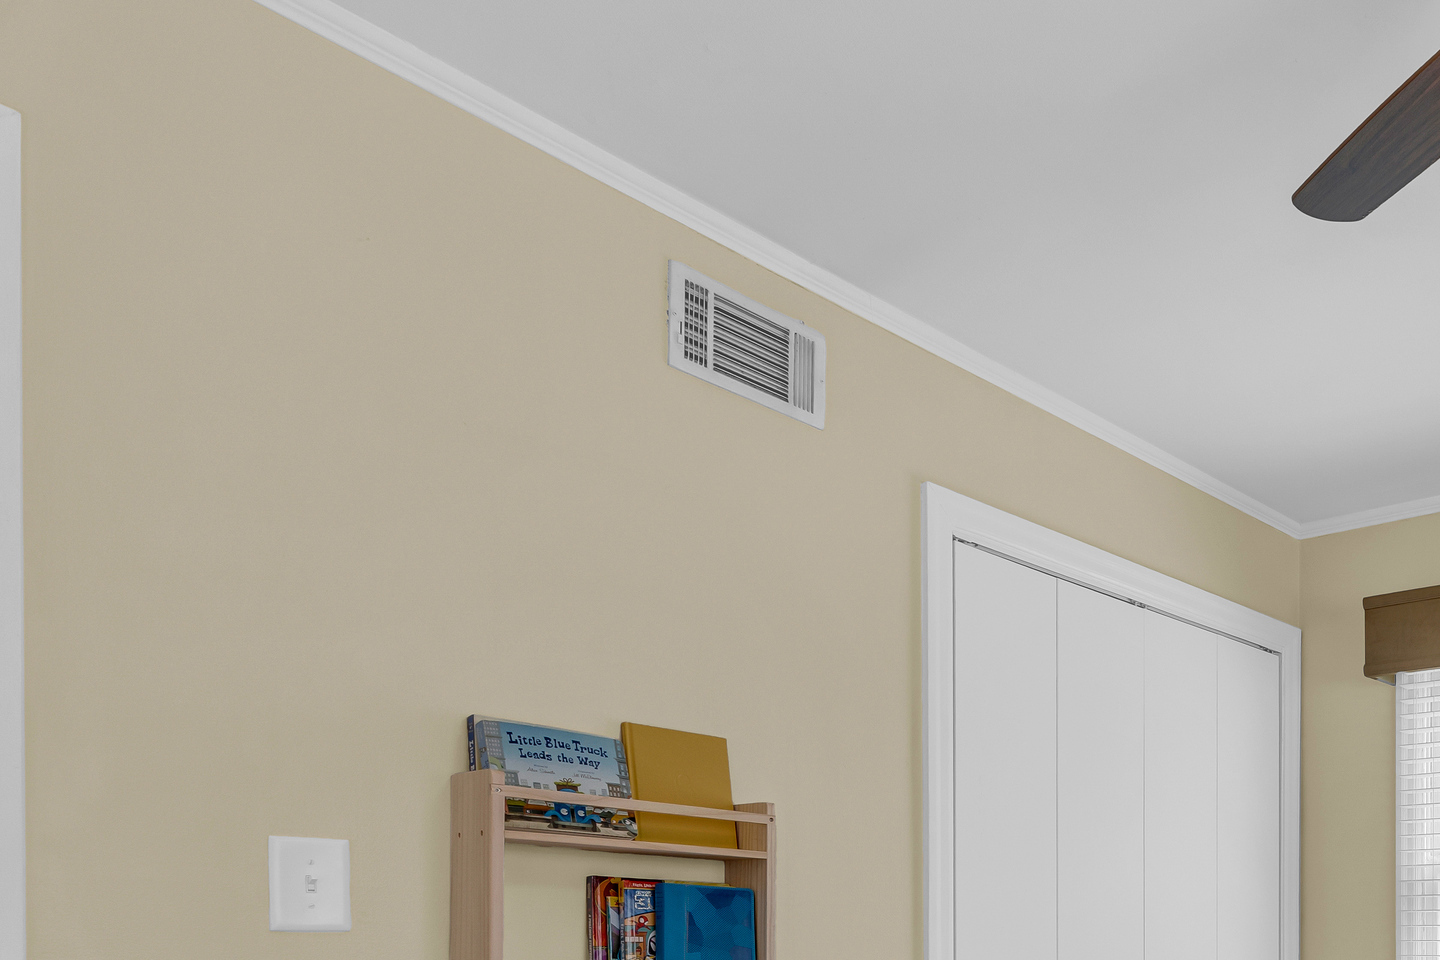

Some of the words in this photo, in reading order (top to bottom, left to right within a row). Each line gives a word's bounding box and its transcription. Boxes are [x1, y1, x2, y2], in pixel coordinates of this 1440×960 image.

[506, 731, 542, 746] Little
[544, 736, 571, 750] Blue
[572, 740, 608, 758] Truck
[518, 748, 552, 761] Leads
[557, 753, 574, 764] the
[577, 756, 601, 769] Way
